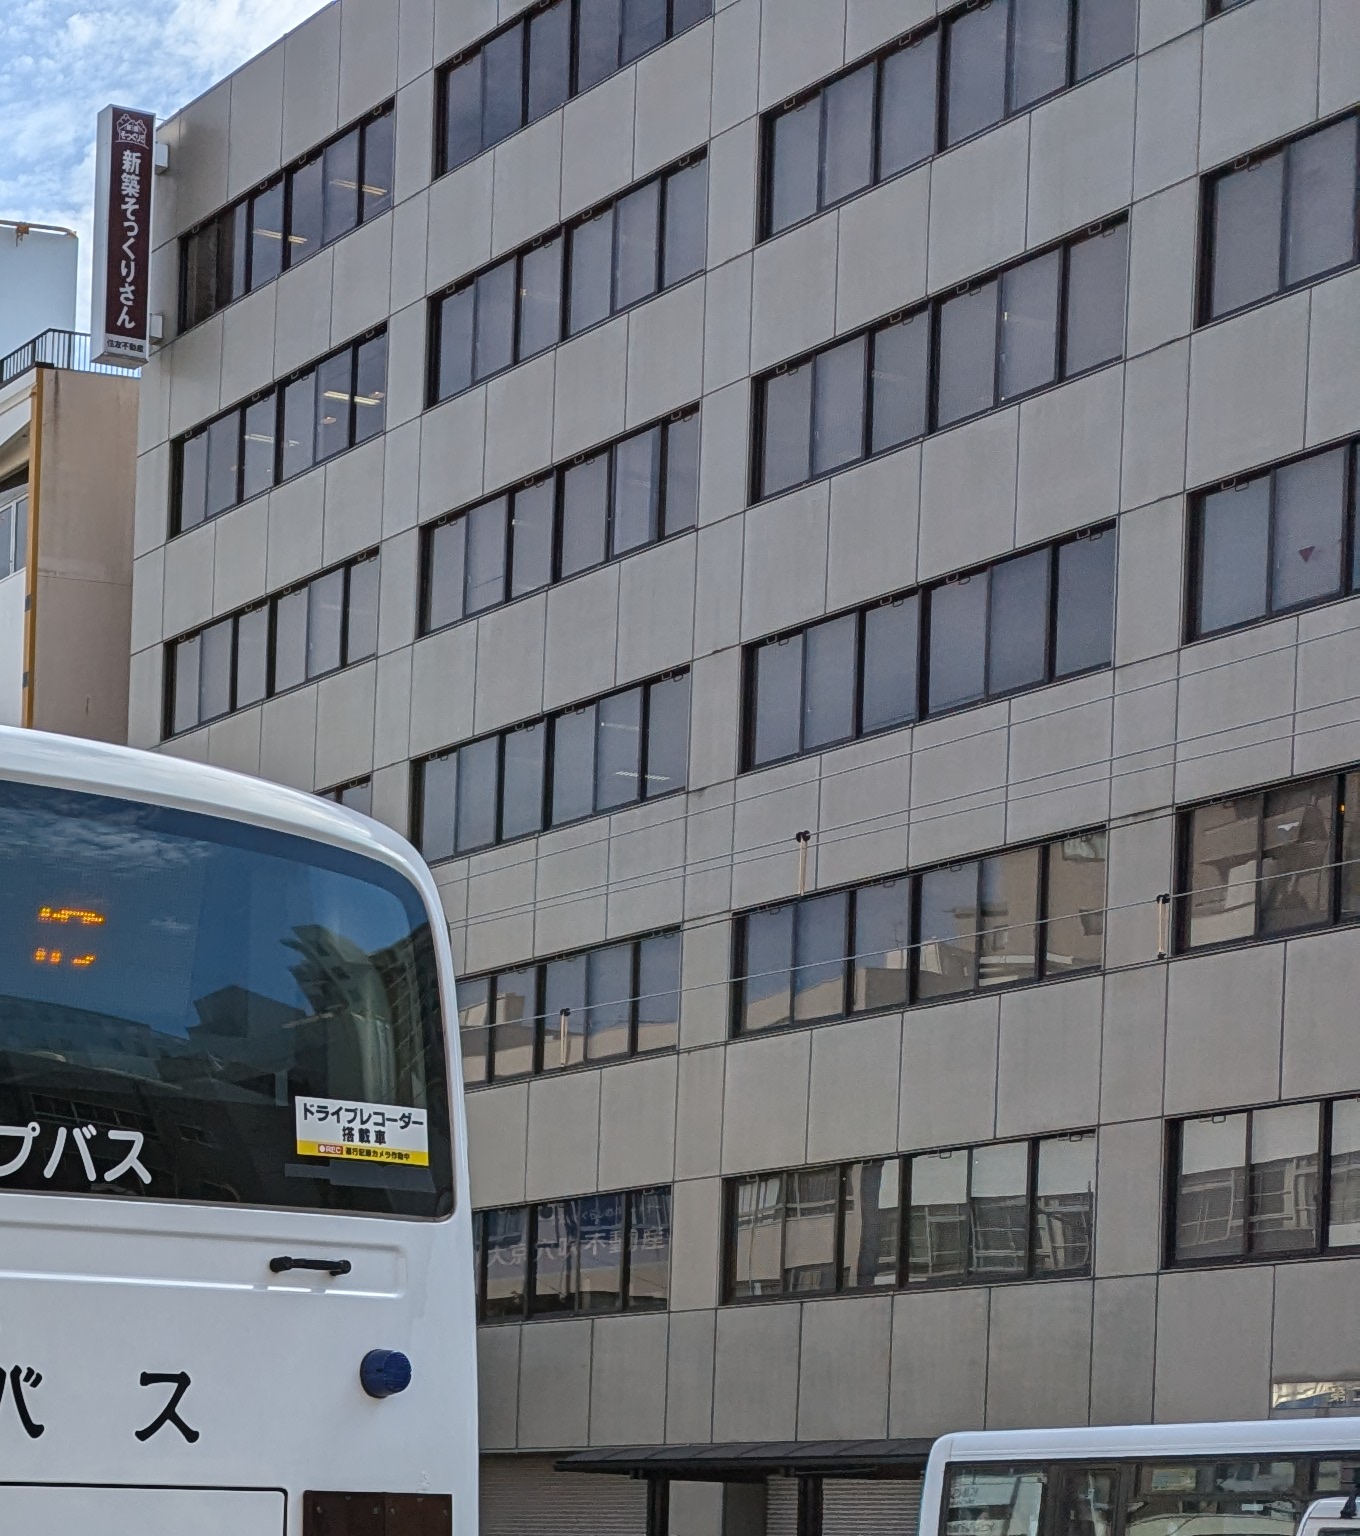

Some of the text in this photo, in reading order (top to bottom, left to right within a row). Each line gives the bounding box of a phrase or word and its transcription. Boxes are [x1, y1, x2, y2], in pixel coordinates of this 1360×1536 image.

[116, 150, 142, 329] 新築そっくりさん
[106, 338, 145, 353] 住友不動産
[303, 1102, 424, 1130] ドライブレコーダー
[342, 1126, 387, 1145] 搭載車
